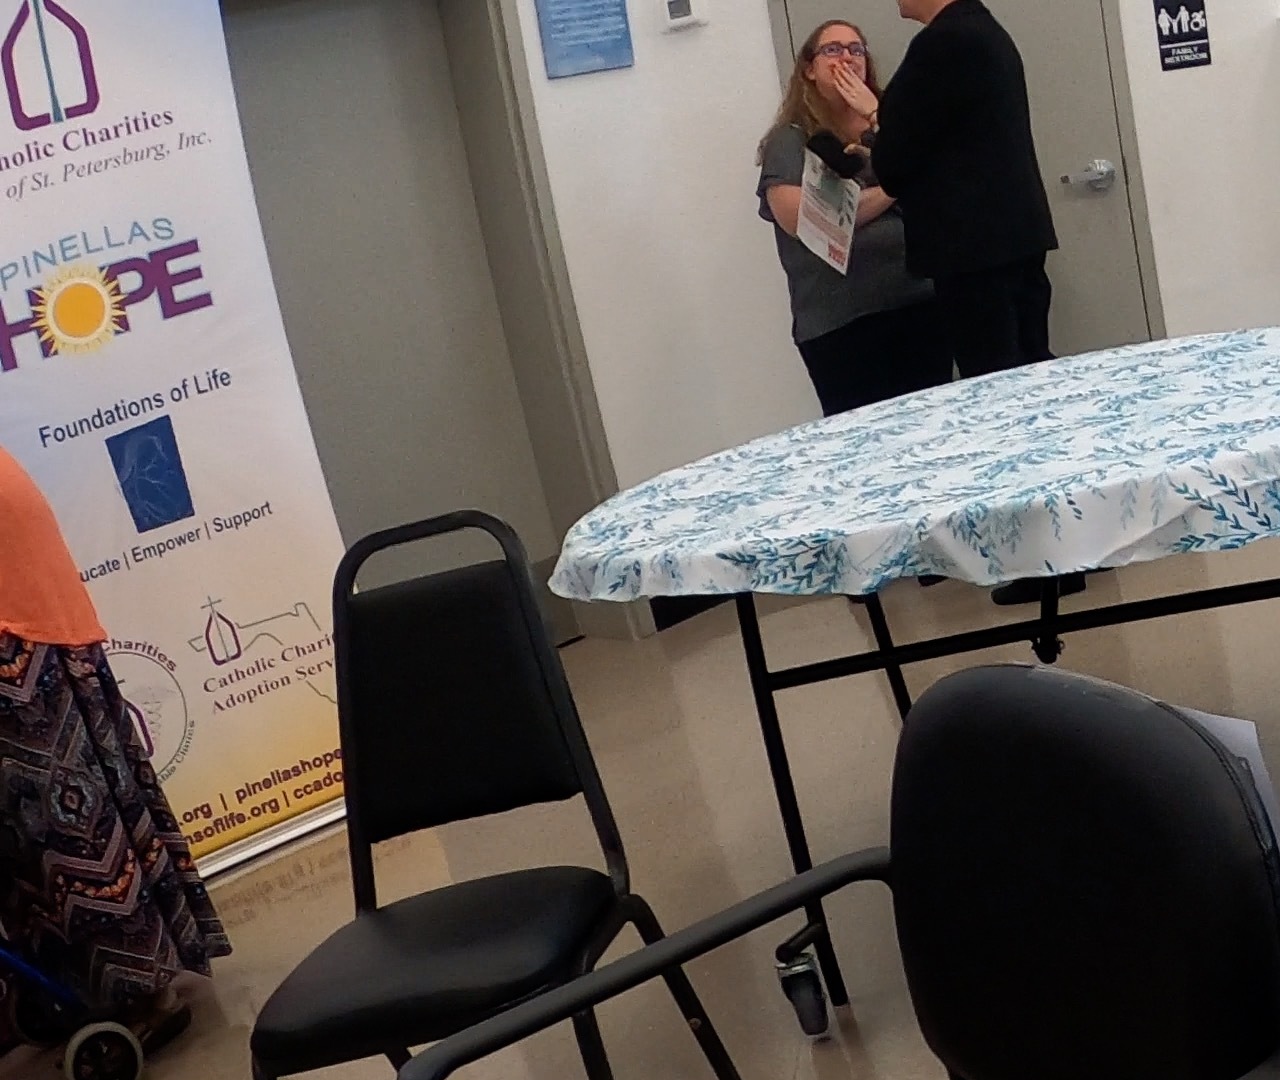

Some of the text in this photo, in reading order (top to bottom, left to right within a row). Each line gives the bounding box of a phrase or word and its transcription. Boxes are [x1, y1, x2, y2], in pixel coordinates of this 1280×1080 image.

[62, 110, 174, 152] Charities
[6, 131, 212, 201] of St. Petersburg, Inc.
[0, 218, 175, 291] PINELLAS
[38, 368, 232, 448] Foundations of Life
[131, 527, 202, 564] Empower
[212, 501, 273, 534] Support
[203, 634, 332, 693] Catholic Chari
[212, 675, 291, 715] Adoption
